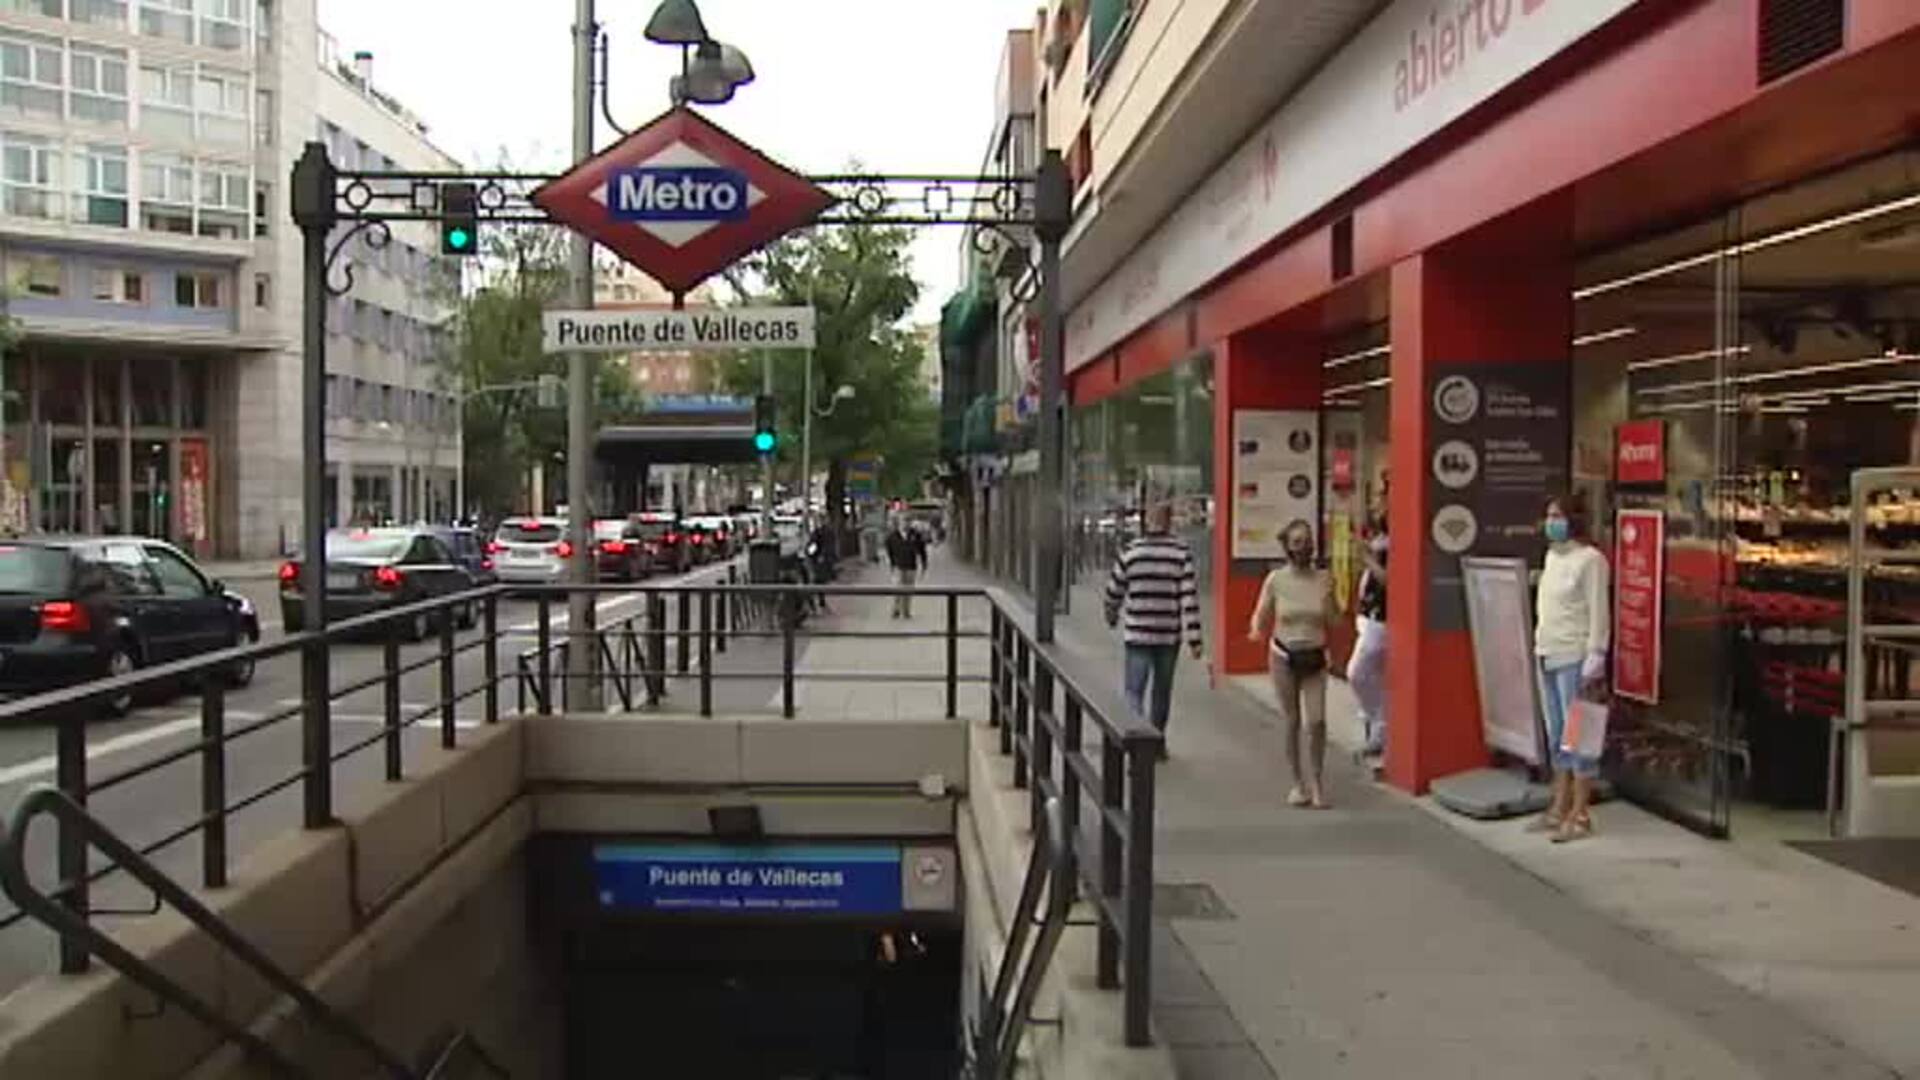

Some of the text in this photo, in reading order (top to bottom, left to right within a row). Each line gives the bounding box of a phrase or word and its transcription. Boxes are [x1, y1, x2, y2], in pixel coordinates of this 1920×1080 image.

[1394, 0, 1511, 111] abierto
[620, 174, 737, 211] Metro
[558, 315, 798, 345] Puente de Vallecas
[649, 866, 843, 886] Puente de Vallecas
